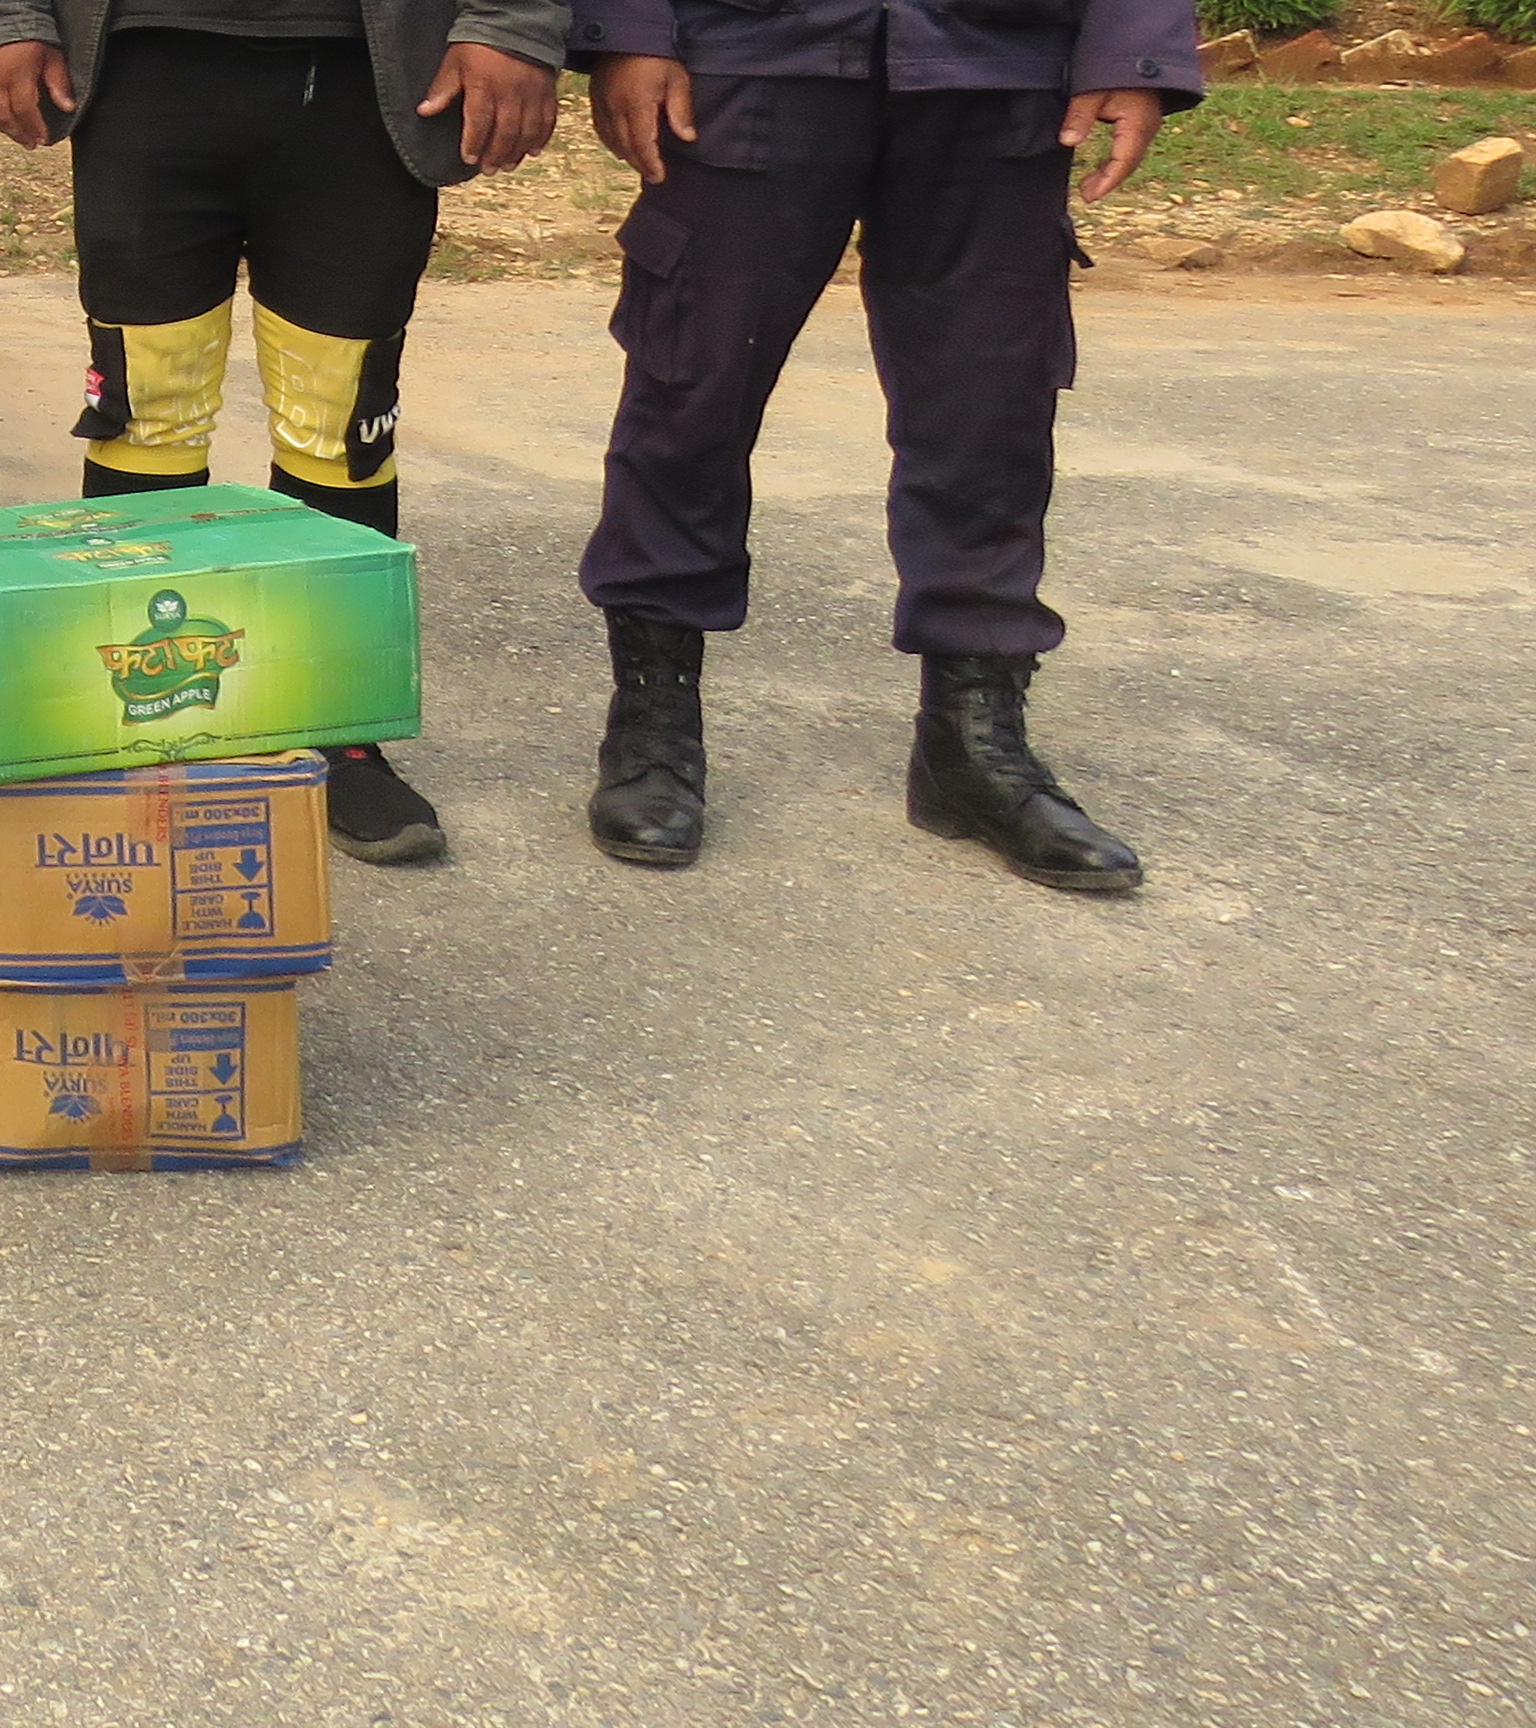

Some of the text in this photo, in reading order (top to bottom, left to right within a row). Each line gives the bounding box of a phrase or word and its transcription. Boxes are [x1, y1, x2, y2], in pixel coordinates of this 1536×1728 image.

[128, 689, 212, 716] GREEN APPLE
[35, 832, 161, 868] पानस
[194, 850, 216, 861] UP
[190, 863, 222, 874] SIDE
[190, 874, 222, 885] THIS
[67, 877, 133, 894] SURYA
[190, 895, 223, 906] CARE
[191, 906, 223, 918] WITH
[182, 918, 232, 931] HANDLE
[13, 1029, 132, 1068] पानस
[171, 1054, 192, 1064] UP
[164, 1066, 197, 1076] SIDE
[45, 1077, 108, 1093] SURYA
[165, 1076, 198, 1087] THIS
[165, 1098, 199, 1109] CARE
[166, 1109, 198, 1120] WITH
[156, 1120, 208, 1132] HANDLE
